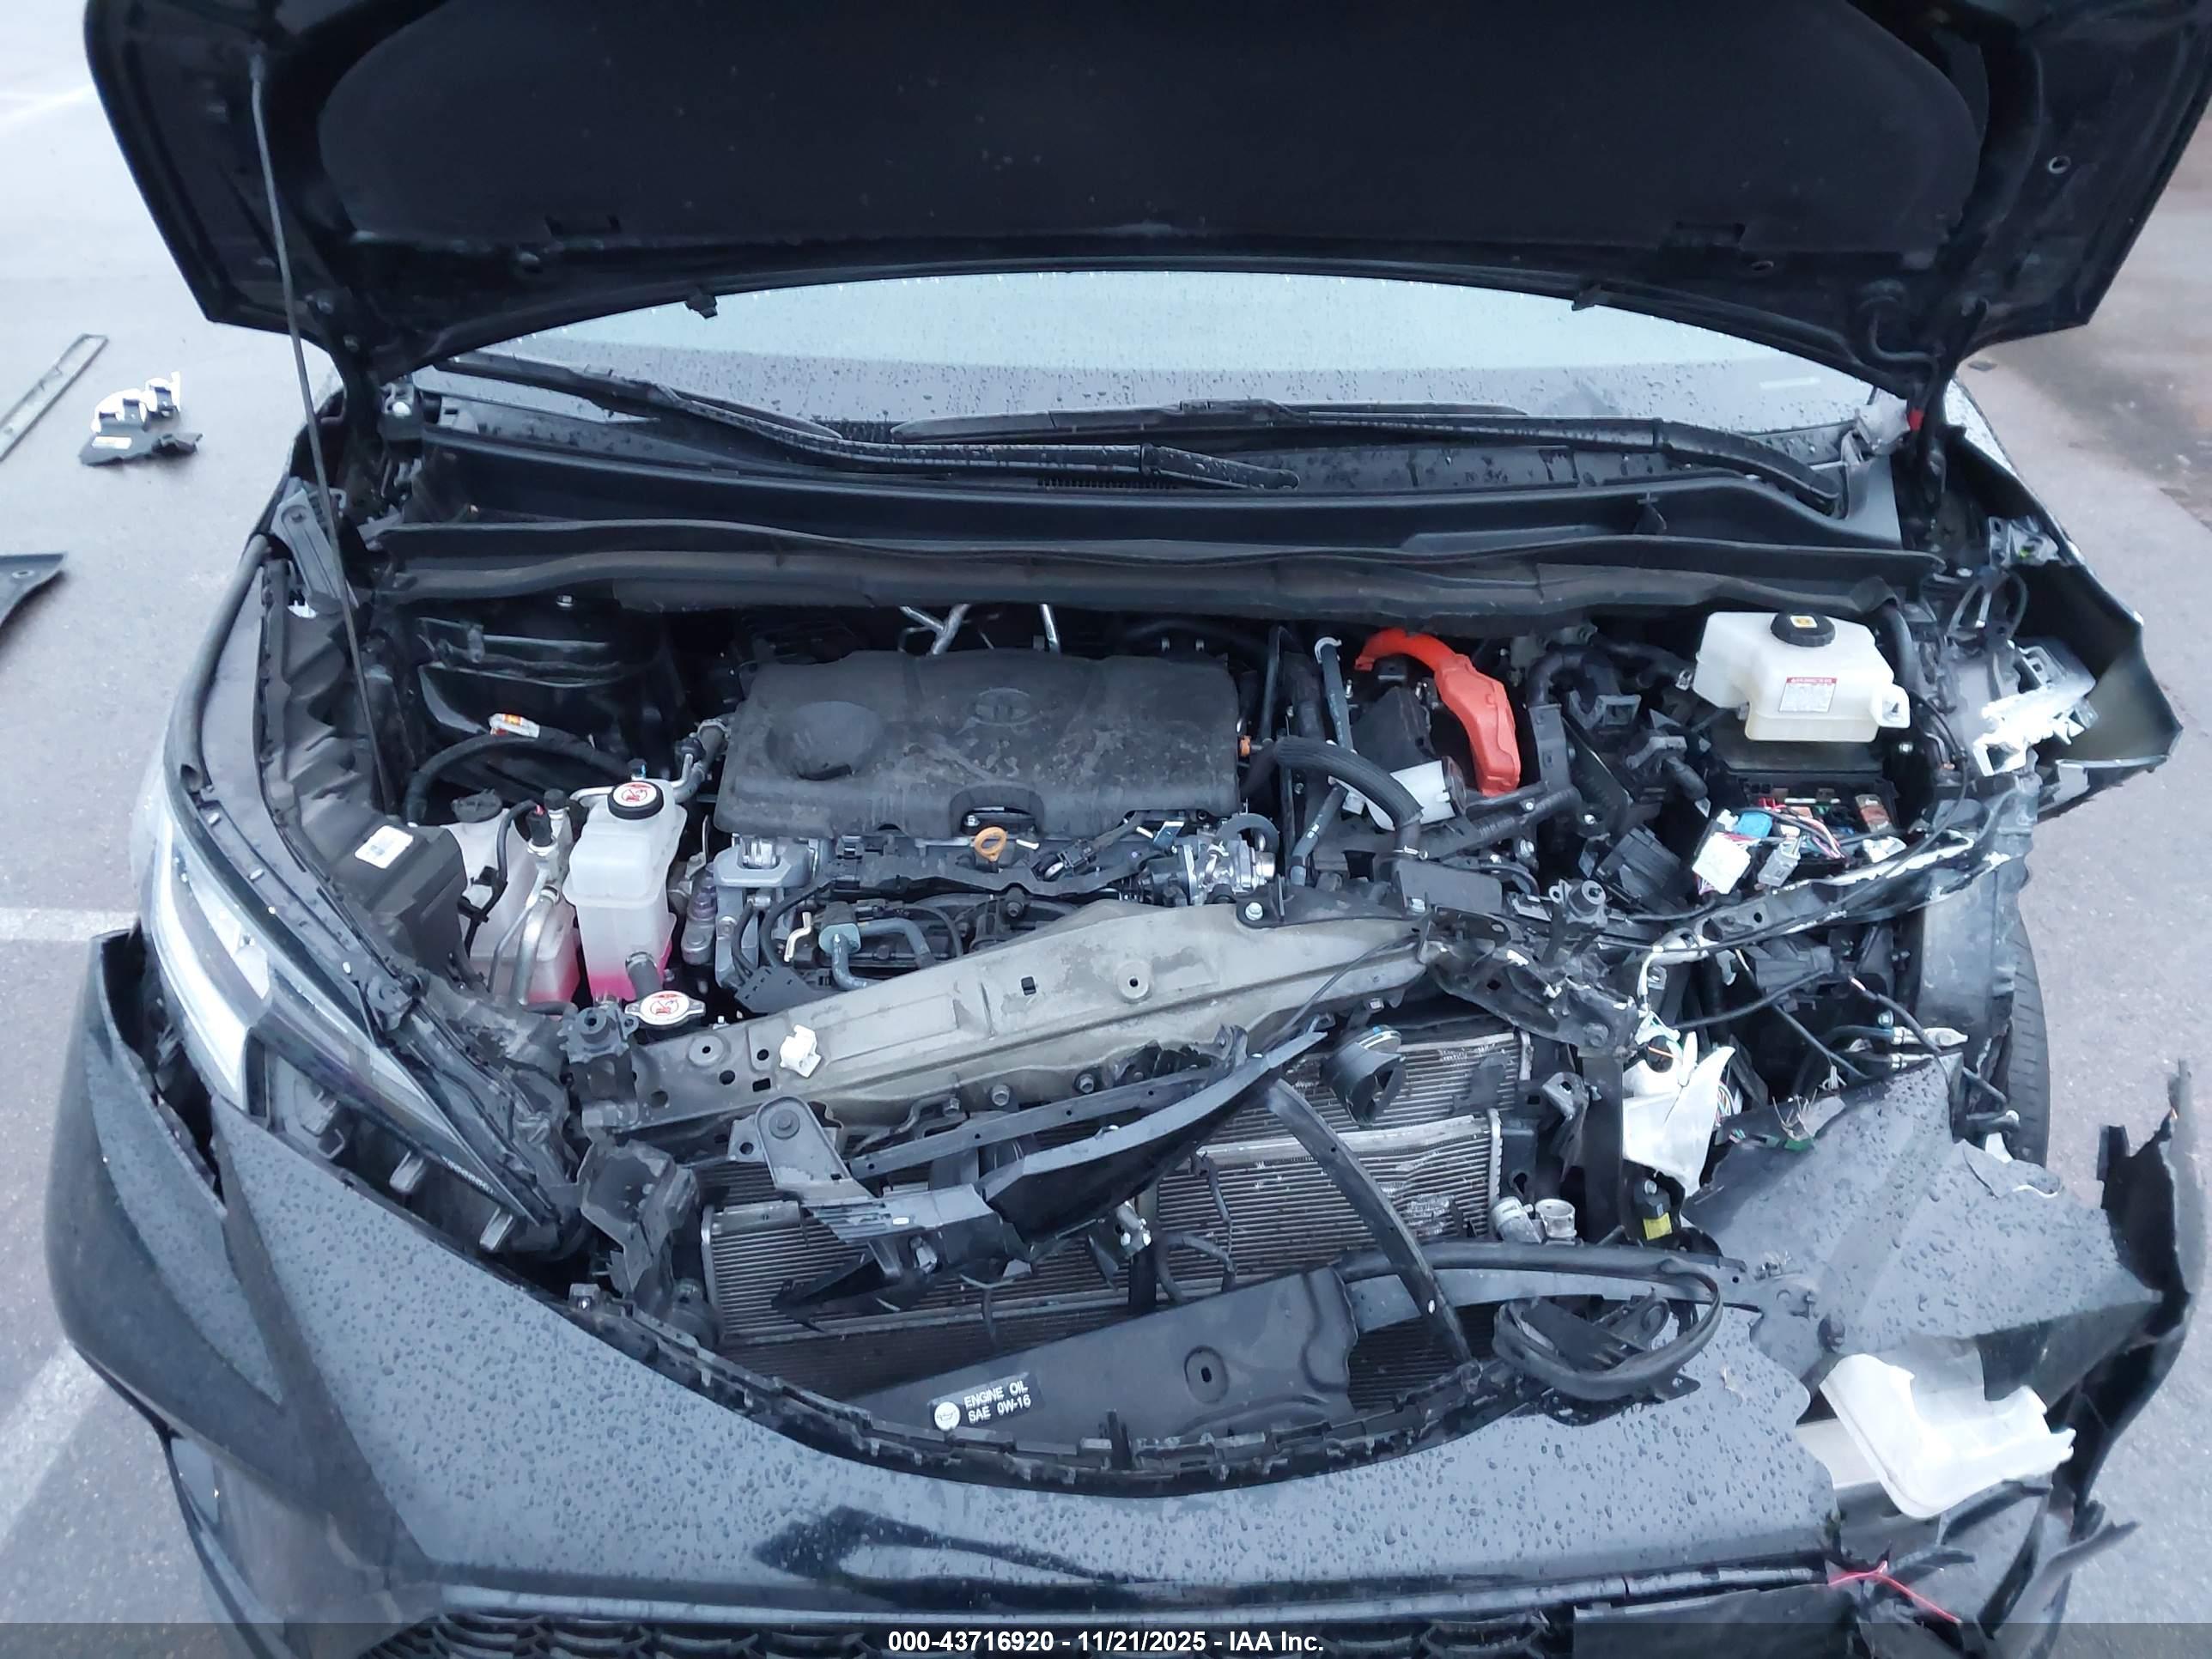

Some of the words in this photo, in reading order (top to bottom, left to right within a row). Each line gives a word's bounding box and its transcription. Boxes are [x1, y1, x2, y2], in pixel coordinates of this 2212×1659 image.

[963, 1386, 1005, 1409] ENGINE
[1009, 1380, 1029, 1396] OIL
[968, 1406, 991, 1425] SAE
[997, 1394, 1031, 1416] 0W-16
